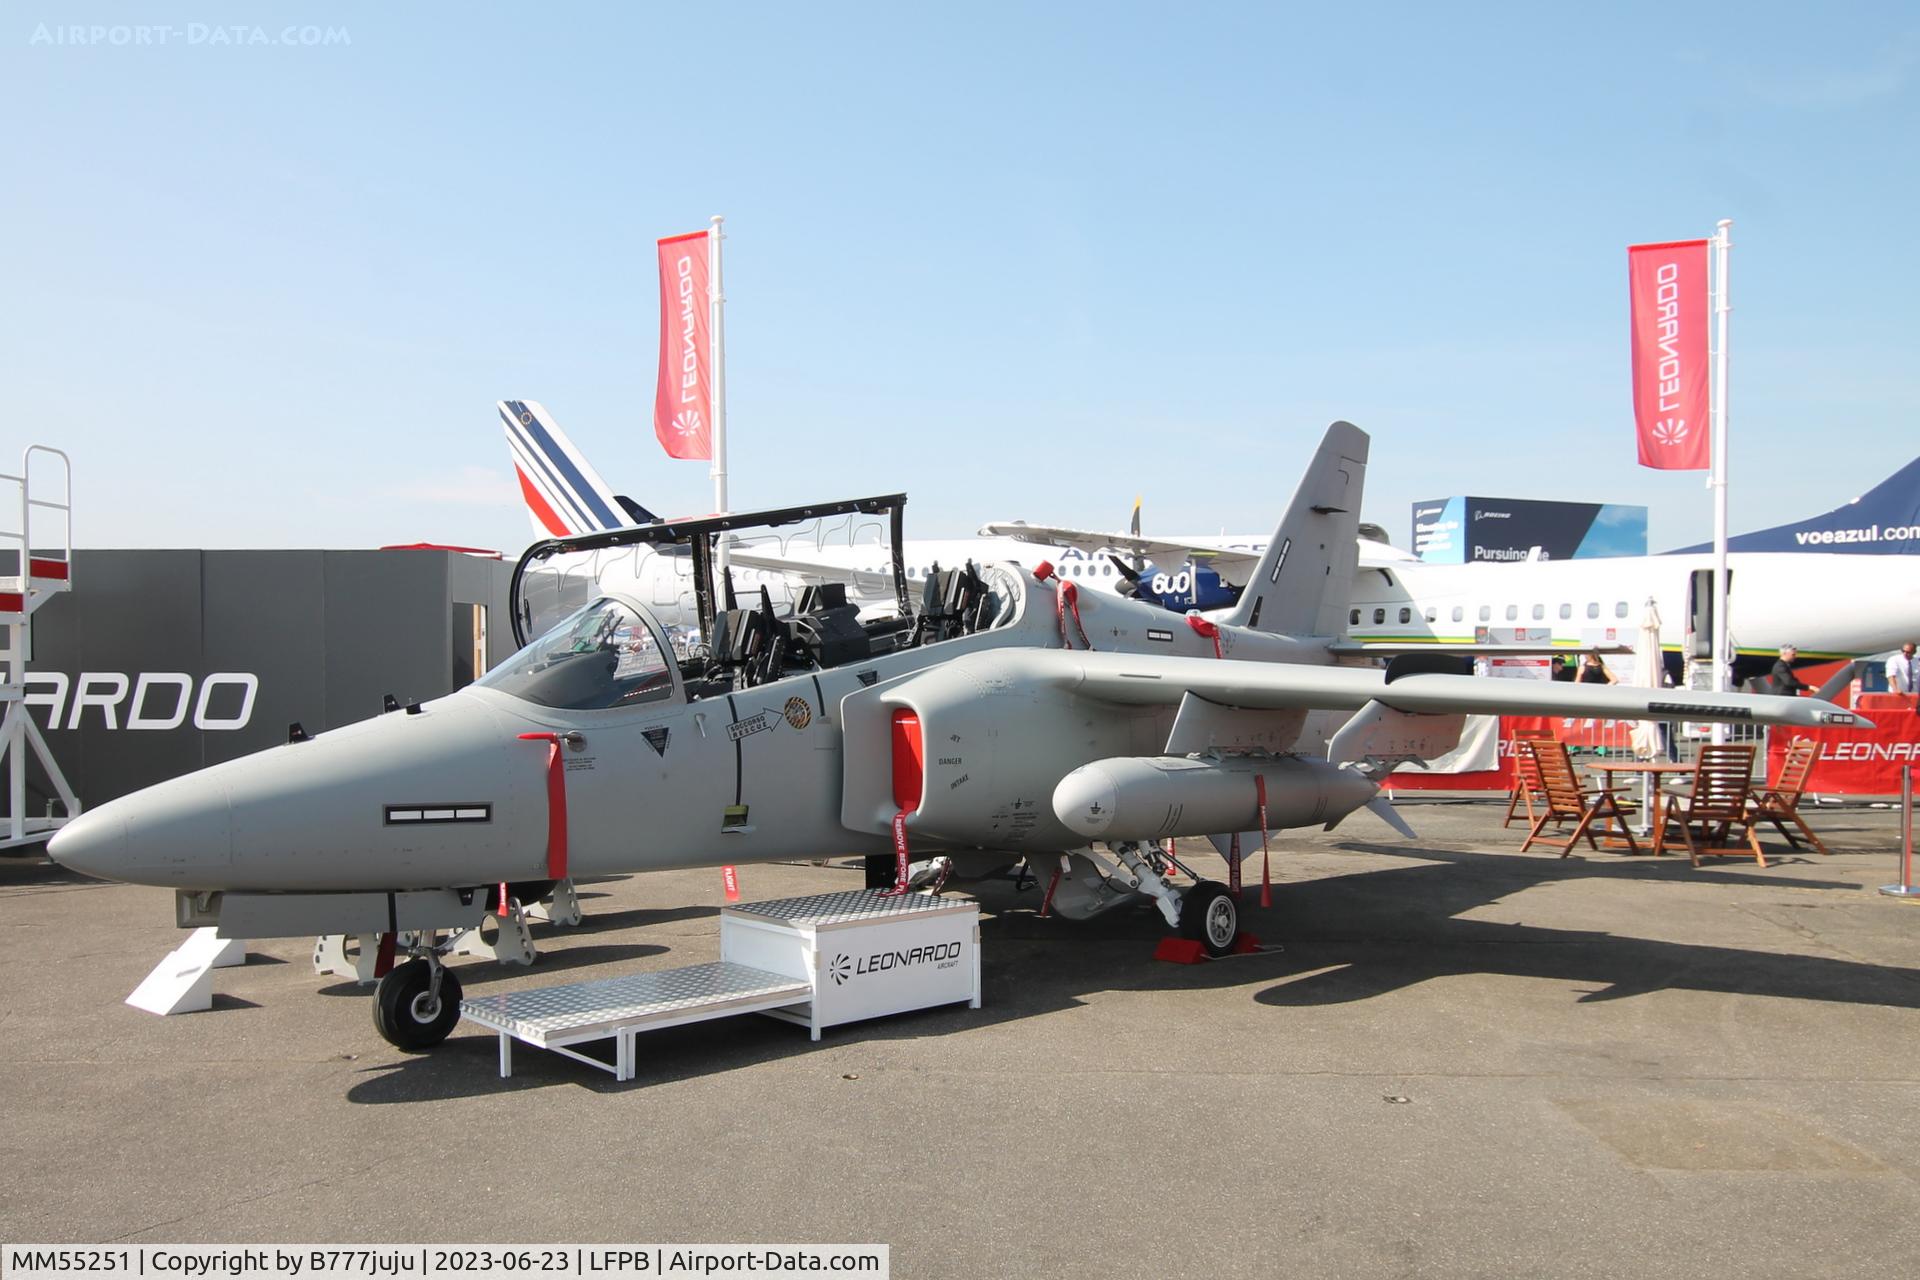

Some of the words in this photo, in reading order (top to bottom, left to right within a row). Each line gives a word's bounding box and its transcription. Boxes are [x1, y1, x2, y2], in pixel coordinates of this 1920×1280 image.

[1152, 572, 1190, 594] 600
[731, 715, 766, 732] SOCCORSO
[733, 721, 767, 738] RESCUE
[938, 757, 962, 766] DANGER
[895, 818, 905, 850] REMOVE
[856, 942, 961, 975] LEONARDO
